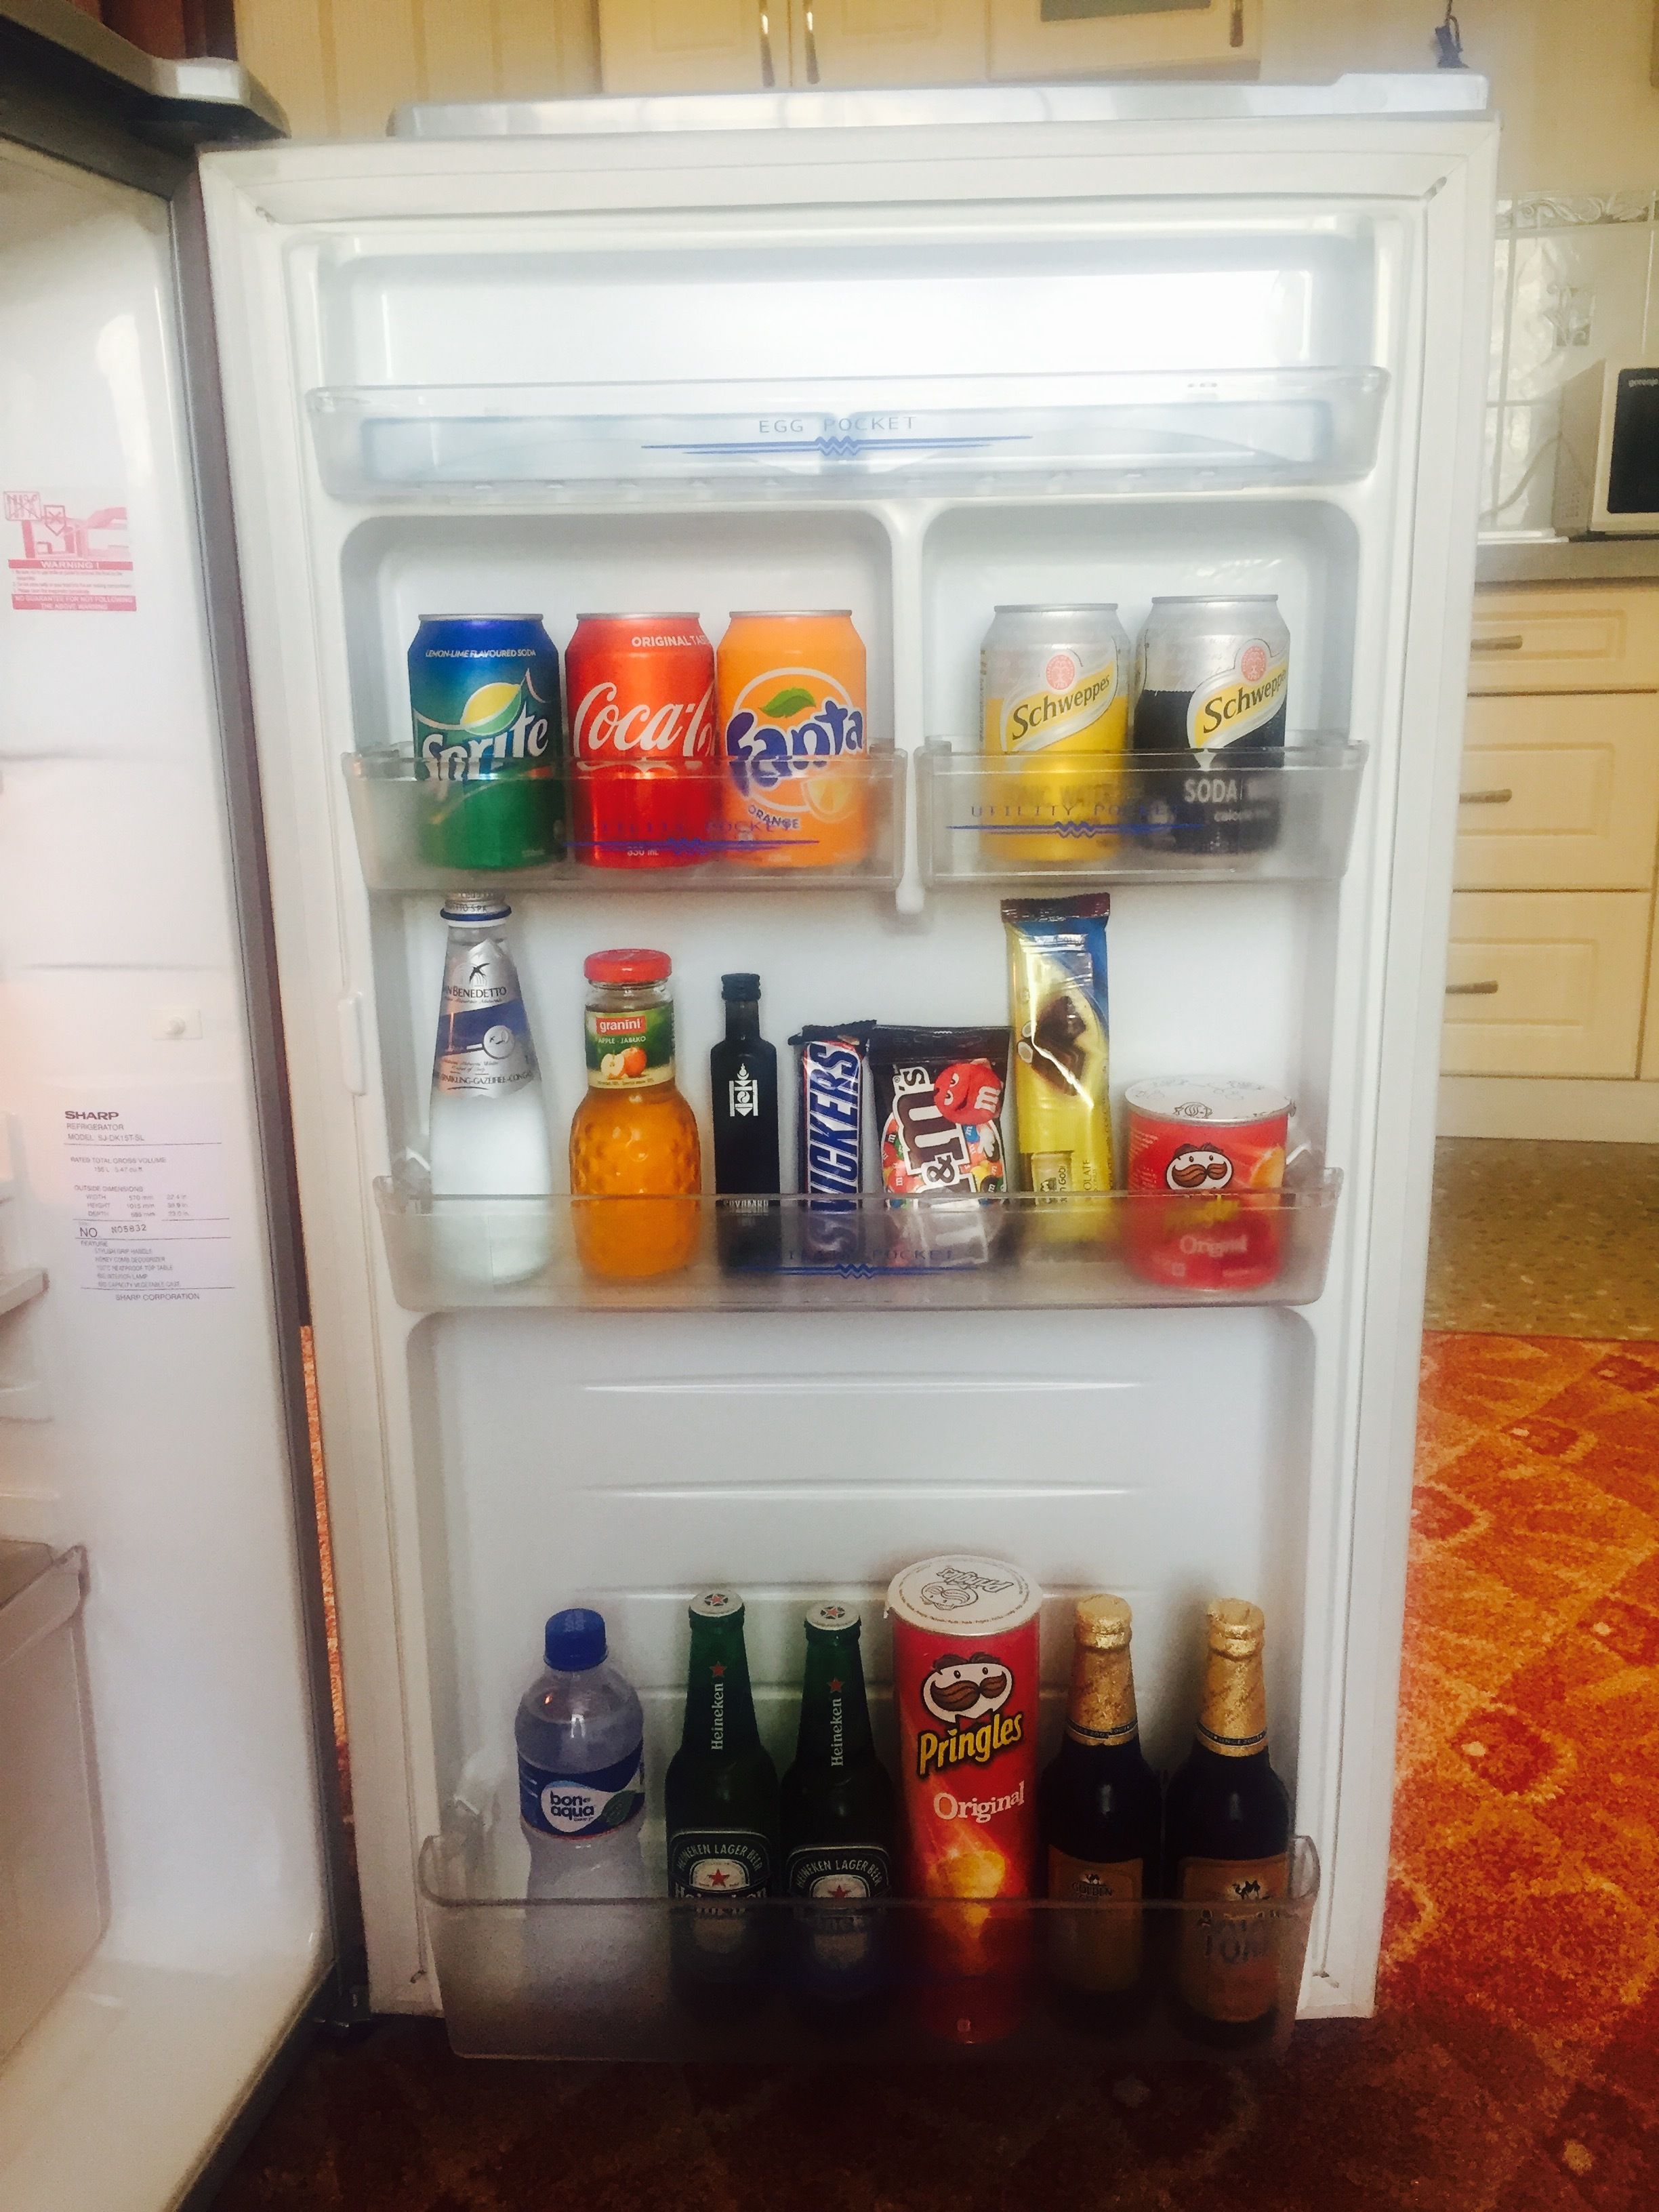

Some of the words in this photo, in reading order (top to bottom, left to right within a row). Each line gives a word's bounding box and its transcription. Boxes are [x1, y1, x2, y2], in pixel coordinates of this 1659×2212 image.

[758, 419, 804, 433] EGG
[823, 416, 917, 432] POCKET
[41, 560, 94, 569] WARNING
[631, 636, 691, 647] ORIGINAL
[470, 649, 516, 657] FLAVOURED
[517, 649, 537, 657] SODA
[1012, 674, 1110, 741] Schweppes
[422, 701, 549, 783] Sprite
[726, 700, 863, 798] Fanta
[1184, 778, 1238, 804] SODA
[747, 804, 800, 829] ORANGE
[453, 985, 507, 999] BENEDETTO
[599, 1018, 641, 1033] granini
[64, 1110, 119, 1120] SHARP
[66, 1122, 125, 1130] REFRIGERATOR
[68, 1133, 94, 1141] MODEL
[79, 1227, 98, 1237] NO
[142, 1293, 200, 1301] CORPORATION
[711, 1683, 724, 1750] Heineken
[830, 1698, 844, 1767] Heineken
[920, 1713, 1023, 1776] Pringles
[933, 1780, 1025, 1824] Original
[550, 1805, 595, 1821] aqua
[677, 1844, 711, 1871] HEINEKEN
[714, 1844, 748, 1857] LAGER
[746, 1849, 763, 1871] BEER
[797, 1860, 832, 1889] HEINEKEN
[835, 1859, 868, 1872] LAGER
[867, 1862, 882, 1887] BEER
